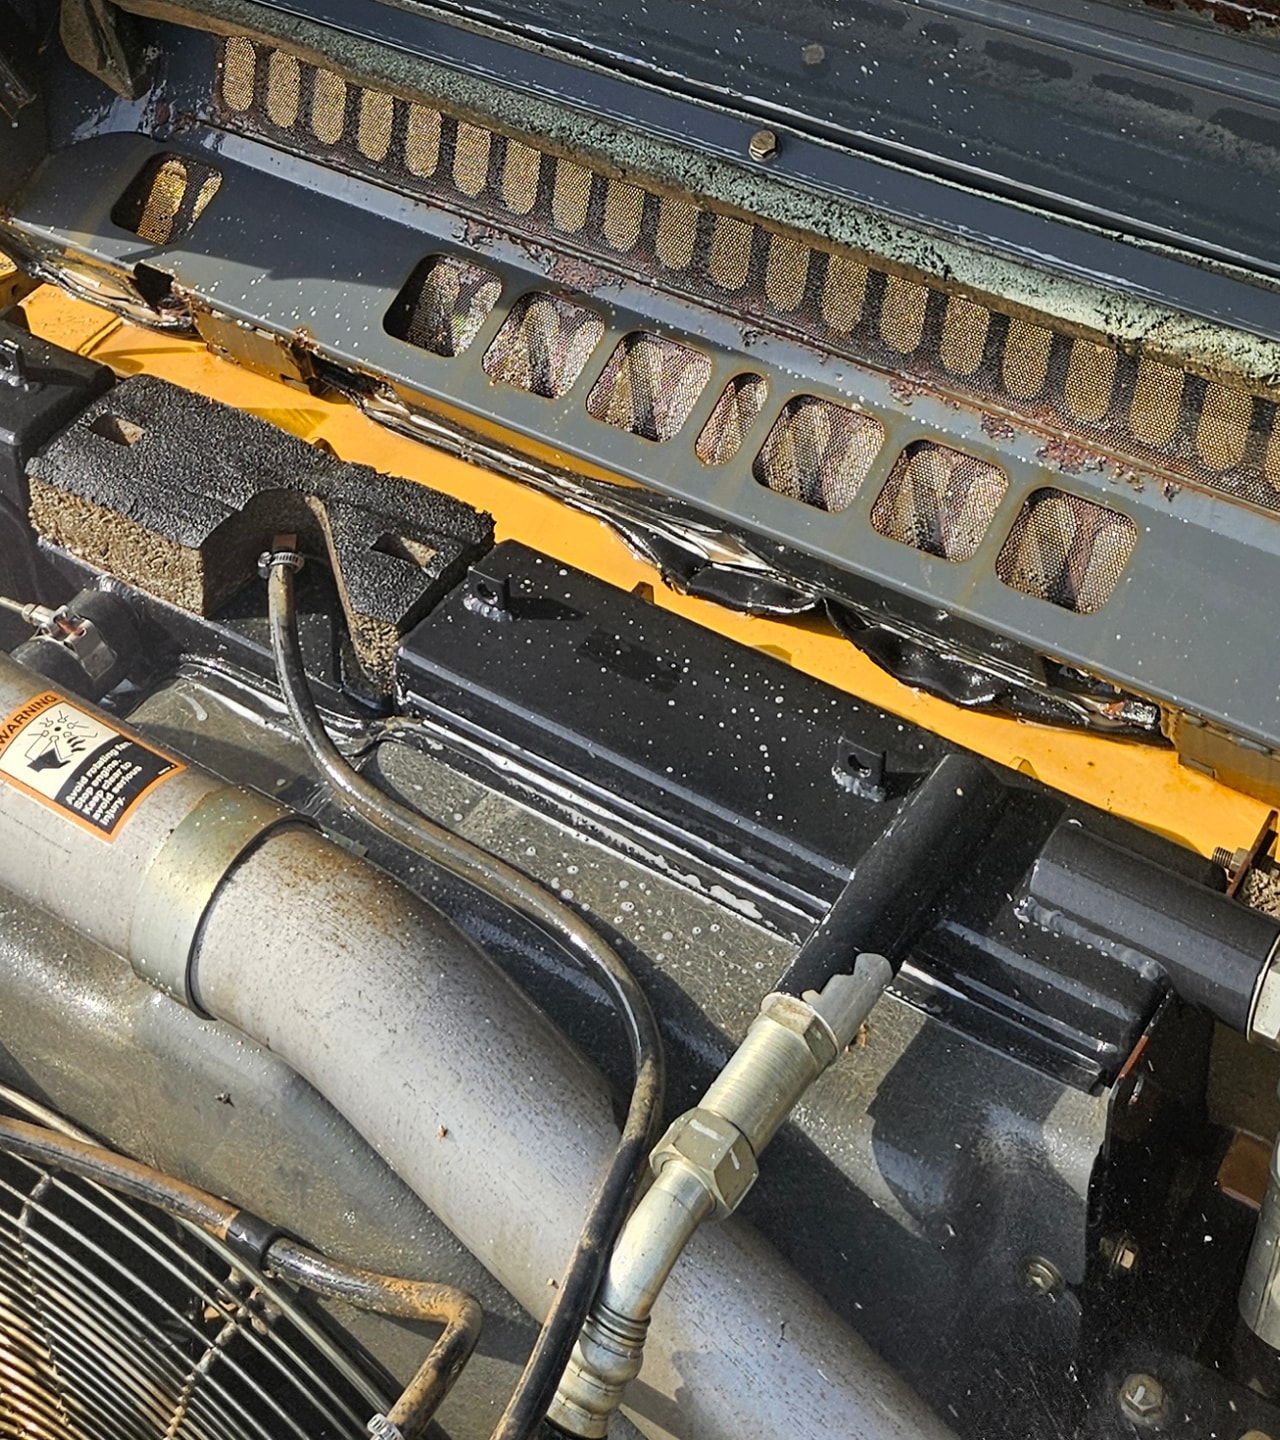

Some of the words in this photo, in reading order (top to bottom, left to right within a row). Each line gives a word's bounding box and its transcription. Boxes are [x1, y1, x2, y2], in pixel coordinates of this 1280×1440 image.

[65, 775, 89, 805] Avoid
[86, 749, 119, 777] rotating
[73, 786, 94, 809] Stop
[91, 759, 122, 787] engine.
[82, 790, 104, 815] Keep
[101, 768, 123, 790] clear
[120, 761, 132, 770] to
[92, 791, 114, 820] avoid
[111, 765, 143, 793] serious
